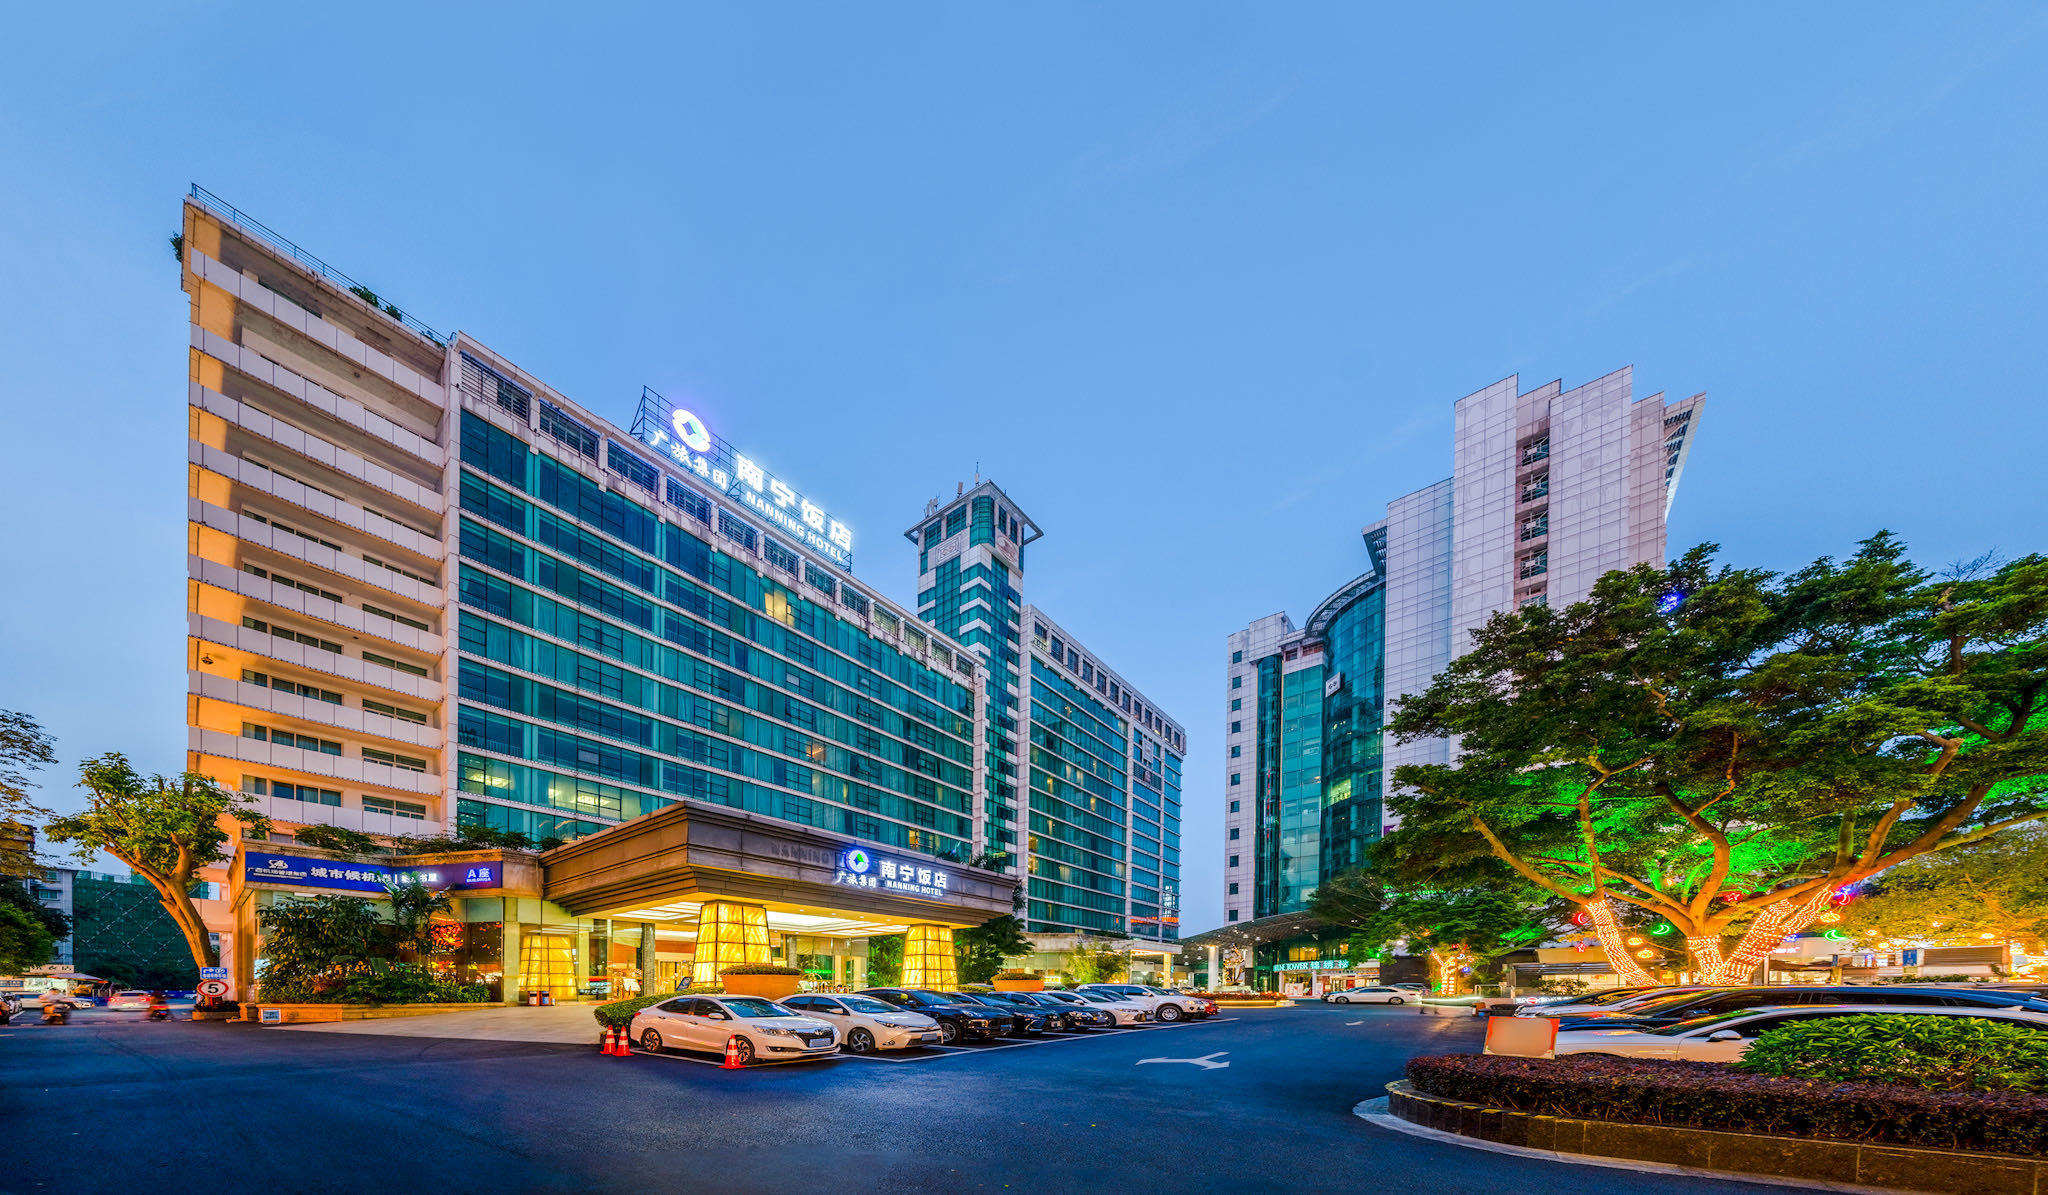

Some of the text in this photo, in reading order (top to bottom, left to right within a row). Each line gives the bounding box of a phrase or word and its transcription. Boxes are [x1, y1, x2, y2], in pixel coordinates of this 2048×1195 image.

[650, 429, 727, 490] 广旅集团
[736, 454, 852, 552] 南宁饭店
[746, 491, 844, 562] NANNING HOTEL
[832, 870, 877, 888] 广旅集团
[879, 861, 947, 889] 南宁饭店
[887, 880, 943, 897] NANNING HOTEL
[207, 983, 219, 994] 5
